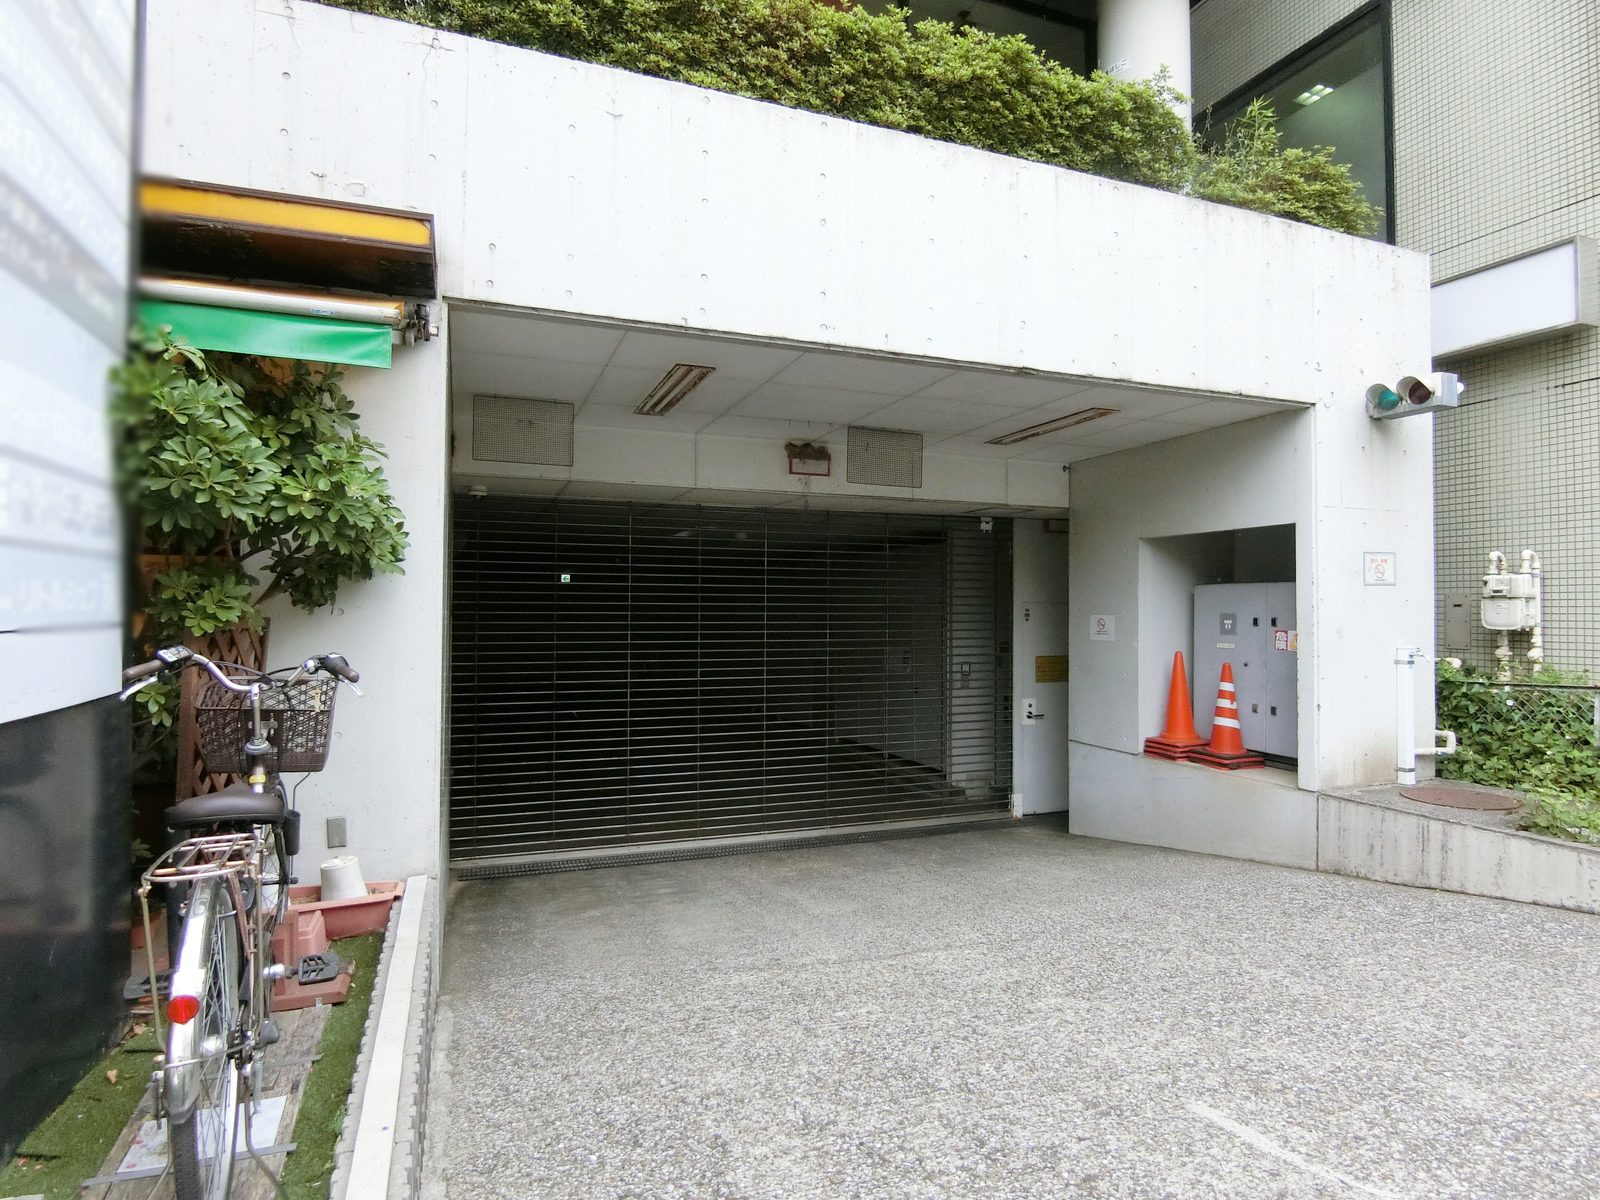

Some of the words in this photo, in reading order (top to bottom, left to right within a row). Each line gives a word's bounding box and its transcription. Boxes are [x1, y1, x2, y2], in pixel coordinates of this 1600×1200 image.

[1106, 58, 1128, 75] はしご
[1275, 631, 1287, 650] 危険
